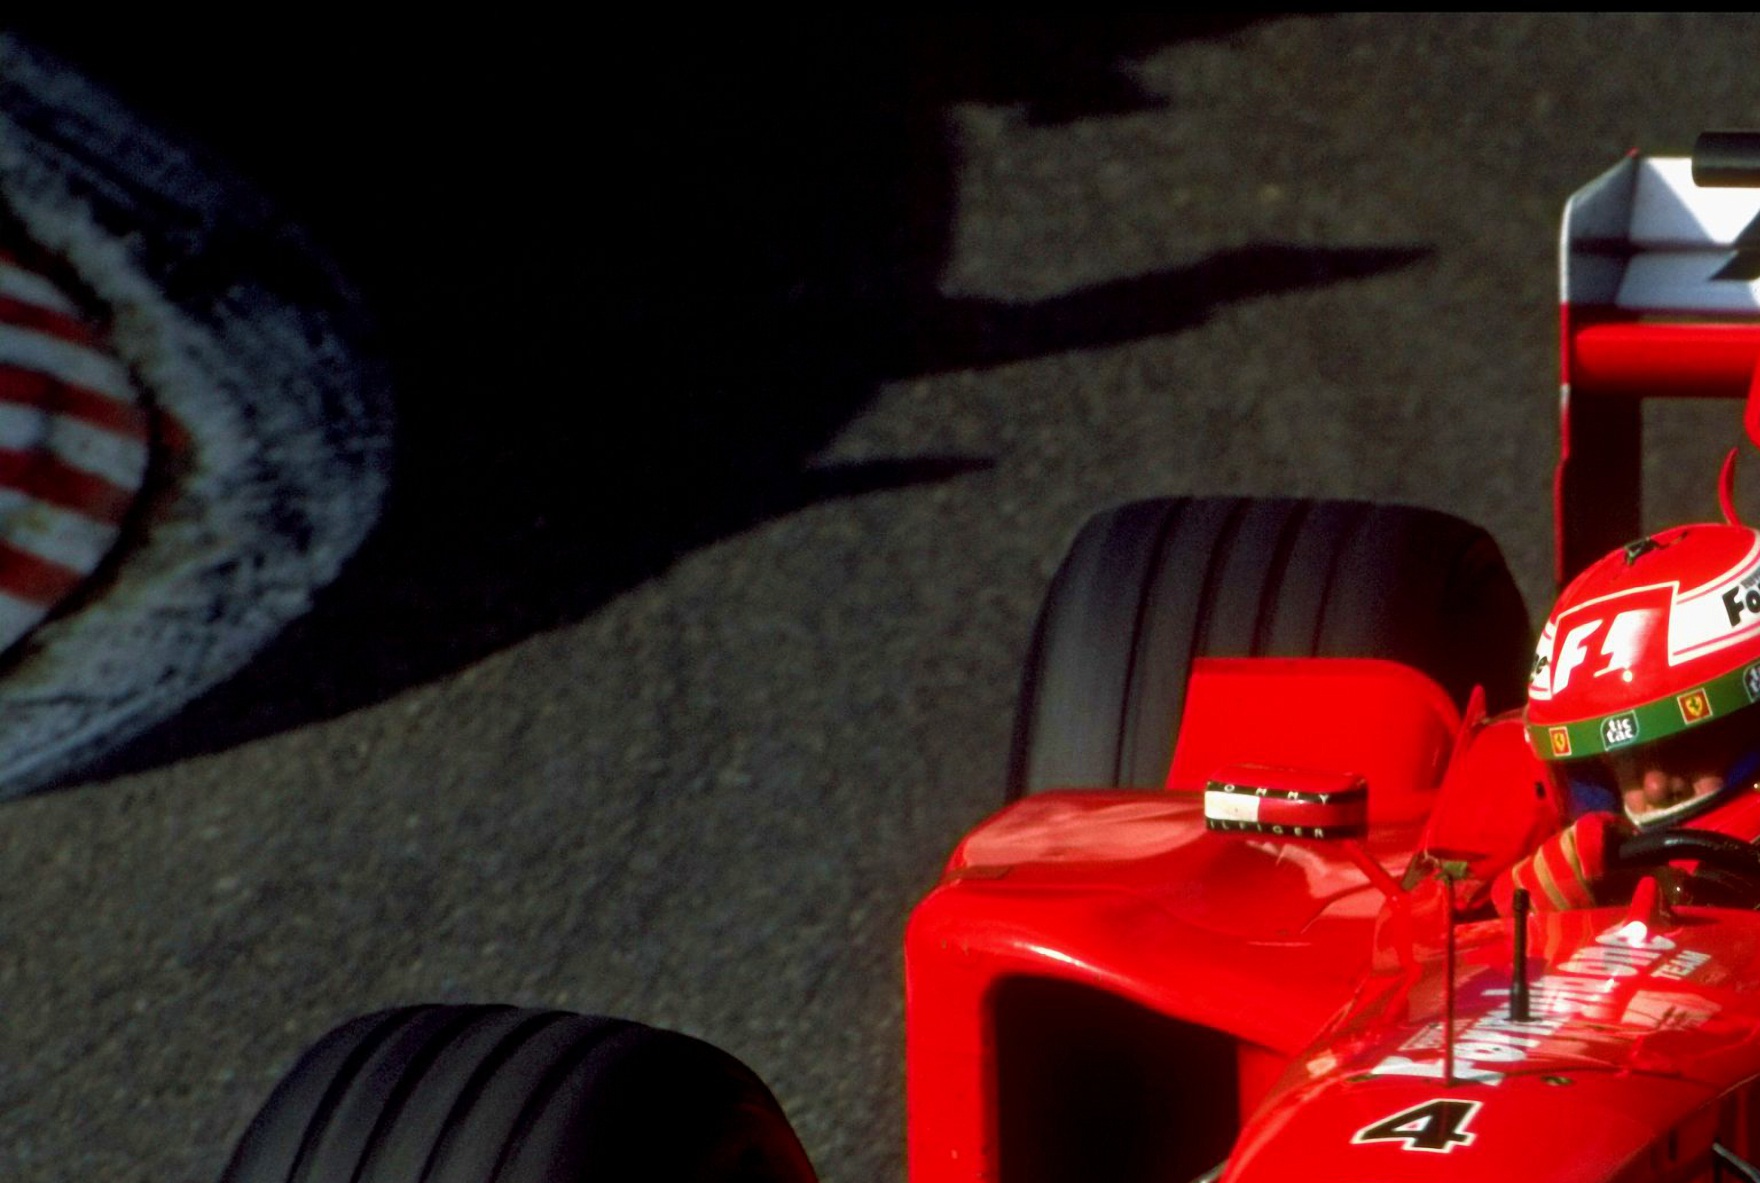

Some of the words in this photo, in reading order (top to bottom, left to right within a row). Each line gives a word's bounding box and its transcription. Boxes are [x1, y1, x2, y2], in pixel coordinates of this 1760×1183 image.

[1552, 609, 1662, 694] F1
[1606, 727, 1634, 743] tac
[1609, 718, 1632, 731] tic
[1224, 783, 1329, 804] OMMY
[1352, 1100, 1481, 1152] 4
